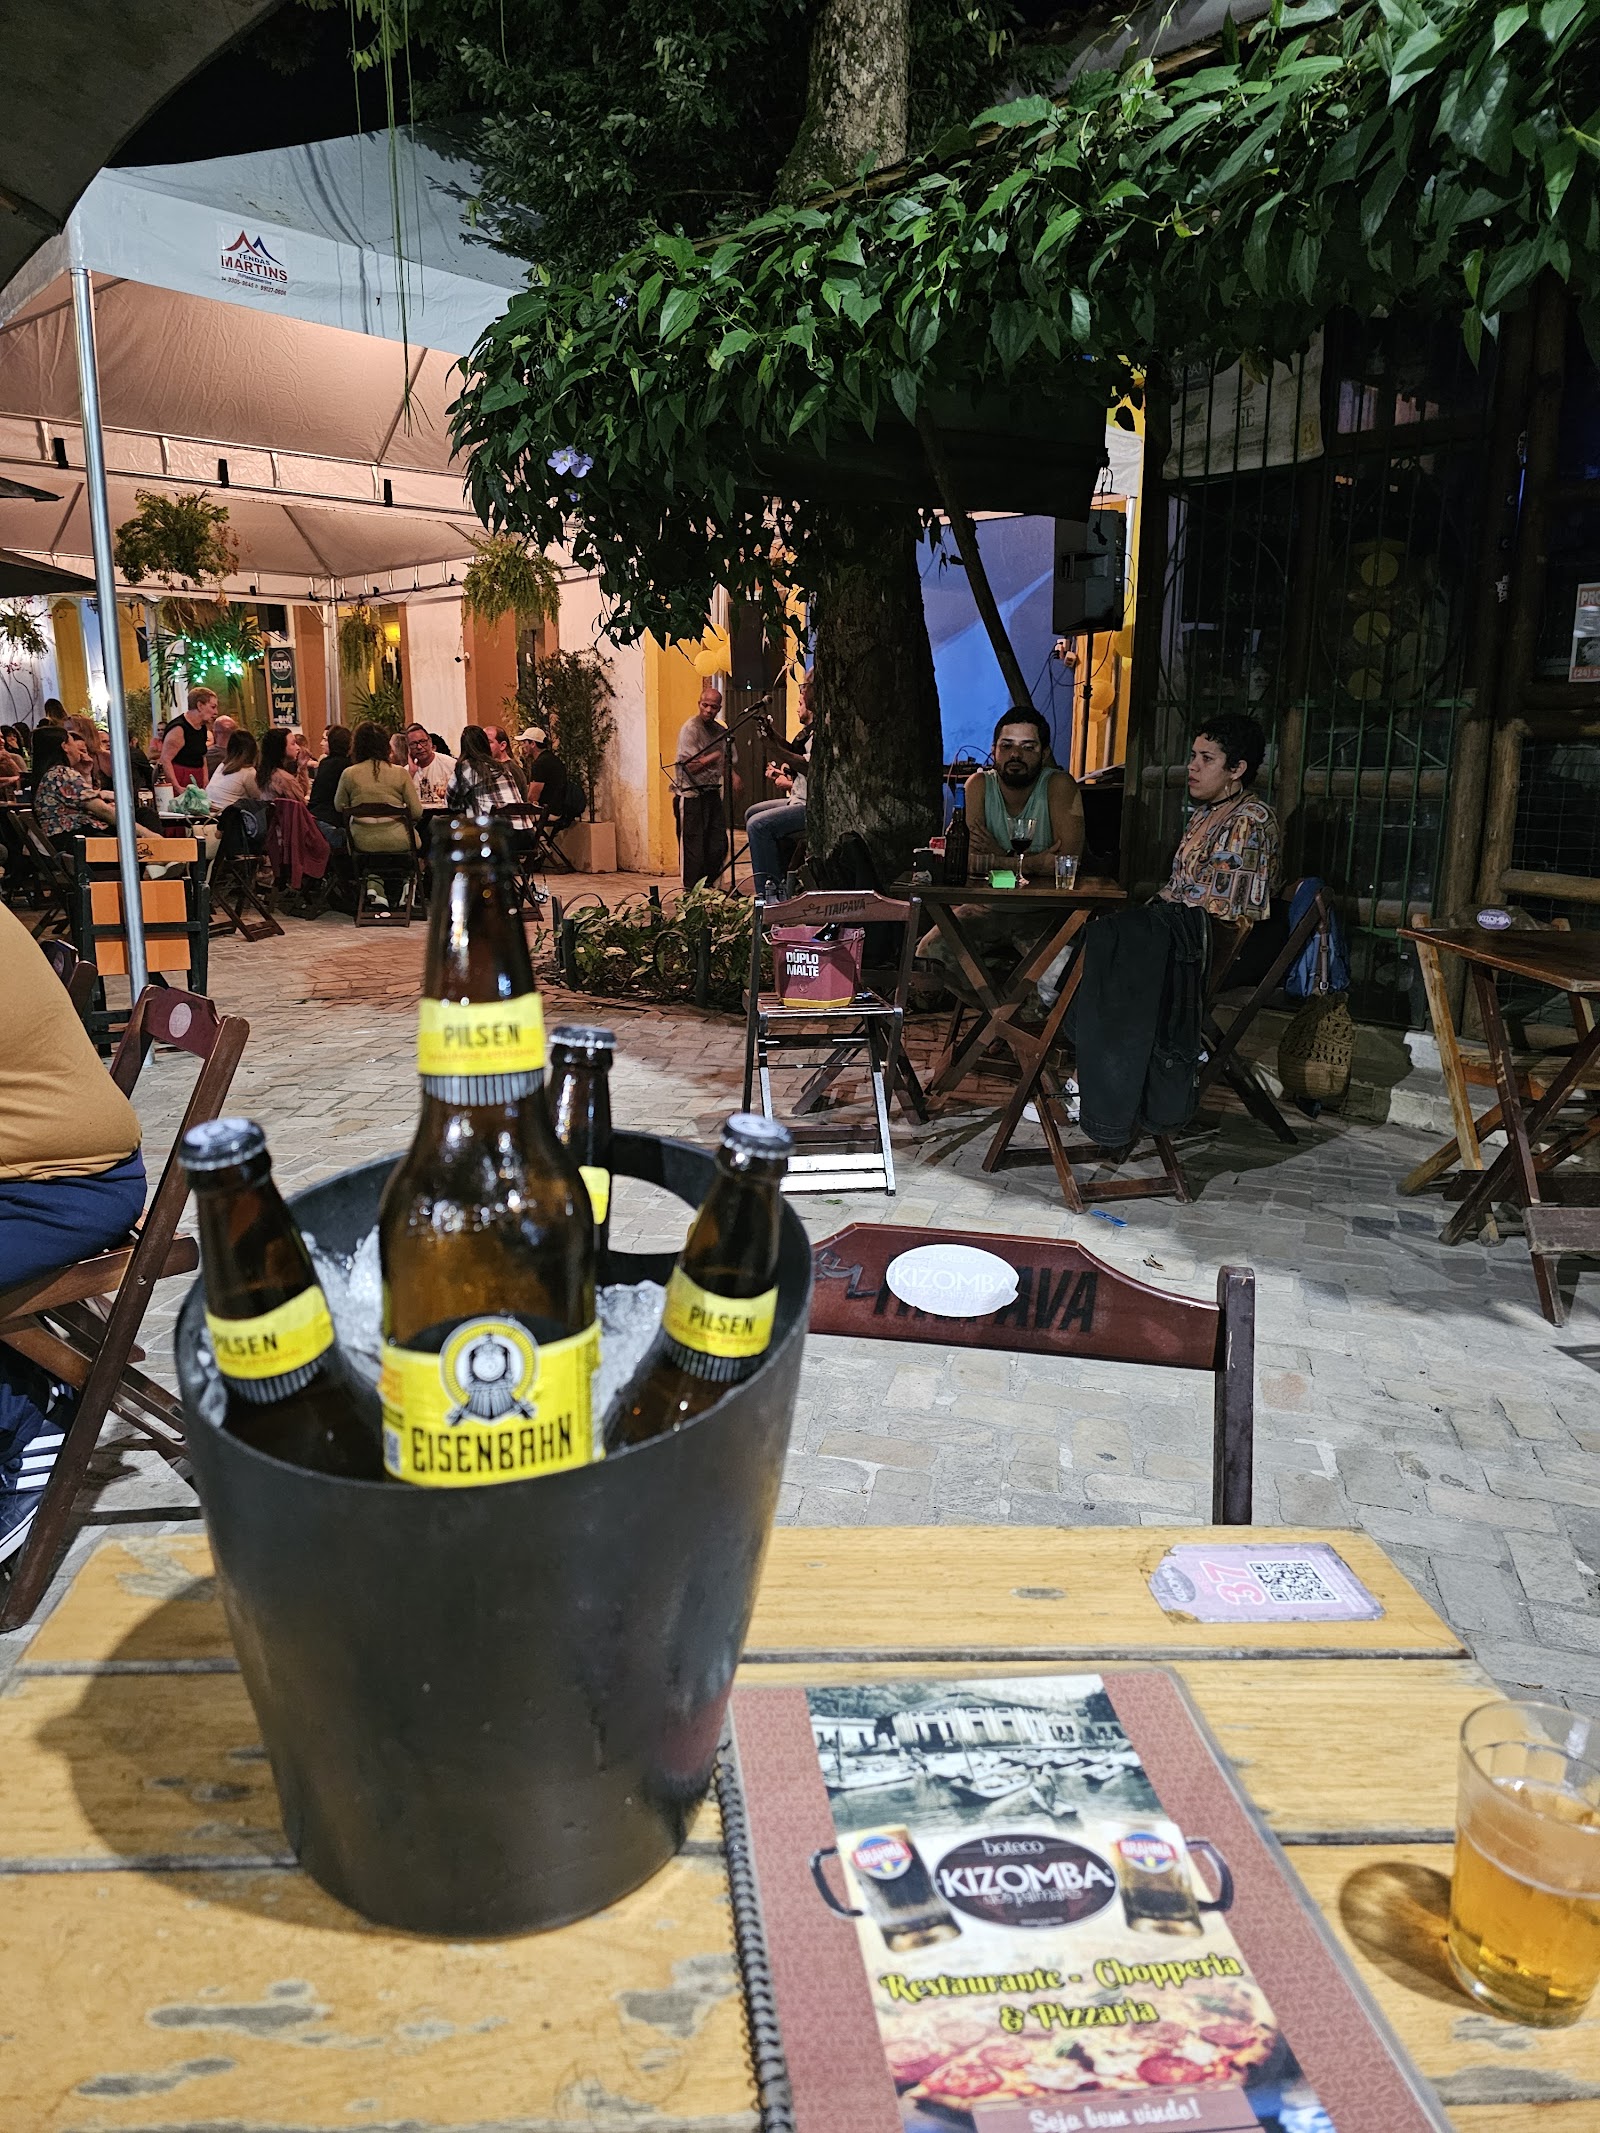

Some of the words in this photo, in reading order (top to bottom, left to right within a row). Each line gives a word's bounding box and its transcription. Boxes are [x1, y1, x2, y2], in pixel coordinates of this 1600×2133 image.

[220, 254, 288, 281] MARTINS
[238, 253, 271, 266] TENDAS
[824, 899, 866, 917] ITAIPAVA
[786, 952, 819, 965] DUPLO
[787, 964, 820, 977] MALTE
[443, 1023, 521, 1049] PILSEN
[894, 1265, 1014, 1294] KIZOMBA
[688, 1305, 756, 1335] PILSEN
[411, 1411, 572, 1473] EISENBAHN
[1200, 1560, 1266, 1606] 37
[858, 1843, 905, 1865] BRAHMA
[982, 1839, 1045, 1857] boteco
[1122, 1840, 1171, 1859] BRAHMA
[939, 1861, 1115, 1898] KIZOMBA
[880, 1969, 1065, 2002] Restaurante
[1093, 1953, 1243, 1991] Chopperia
[1000, 2005, 1024, 2034] &
[1027, 1997, 1160, 2030] Pizzaria
[1028, 2109, 1083, 2133] Seja
[1084, 2104, 1128, 2129] bem
[1133, 2096, 1201, 2126] vindo!
